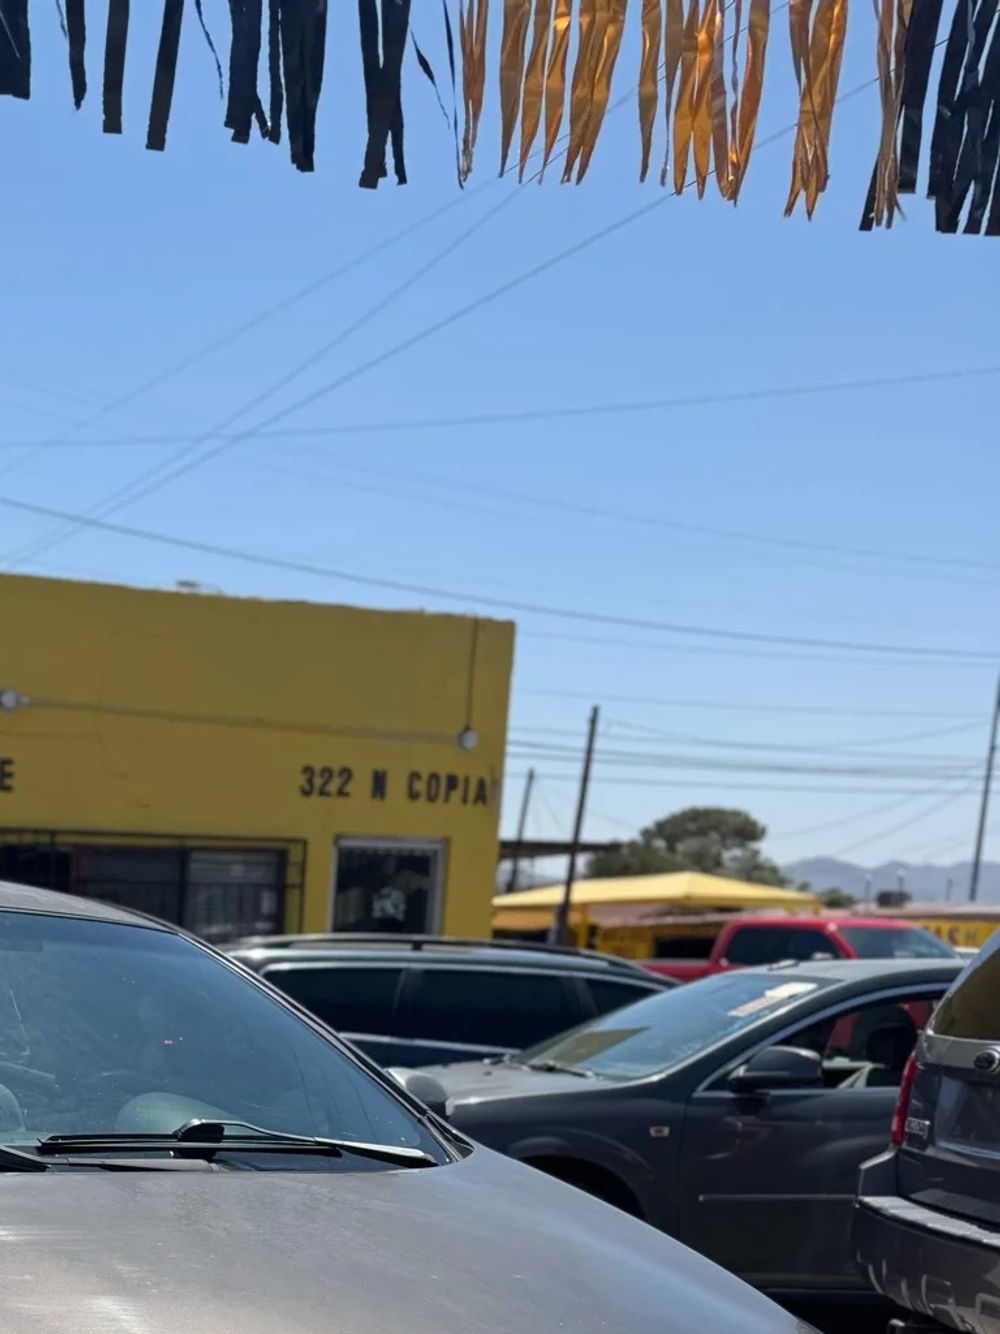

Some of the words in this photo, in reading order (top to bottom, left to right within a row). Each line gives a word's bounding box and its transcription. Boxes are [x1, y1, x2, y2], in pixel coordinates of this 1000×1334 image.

[300, 765, 352, 799] 322
[371, 769, 387, 801] N
[407, 771, 489, 807] COPIA
